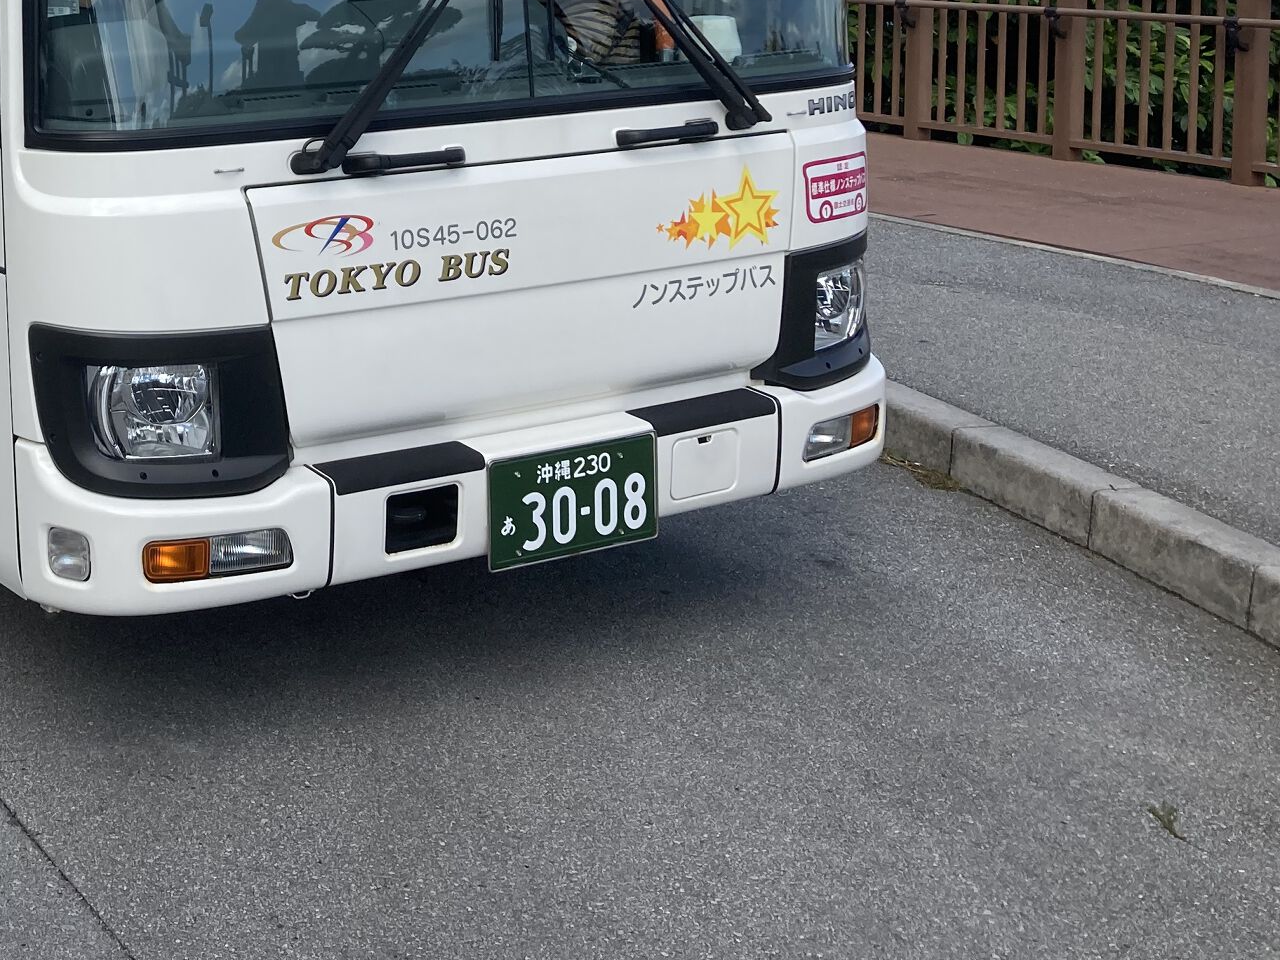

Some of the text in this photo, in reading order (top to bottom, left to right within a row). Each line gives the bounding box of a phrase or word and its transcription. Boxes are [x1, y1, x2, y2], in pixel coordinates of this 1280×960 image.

[808, 90, 856, 116] HINO
[390, 218, 517, 251] 10S45-062
[284, 248, 510, 301] TOKYO BUS
[632, 265, 776, 309] ノンステップバス
[500, 472, 648, 552] あ 30-08
